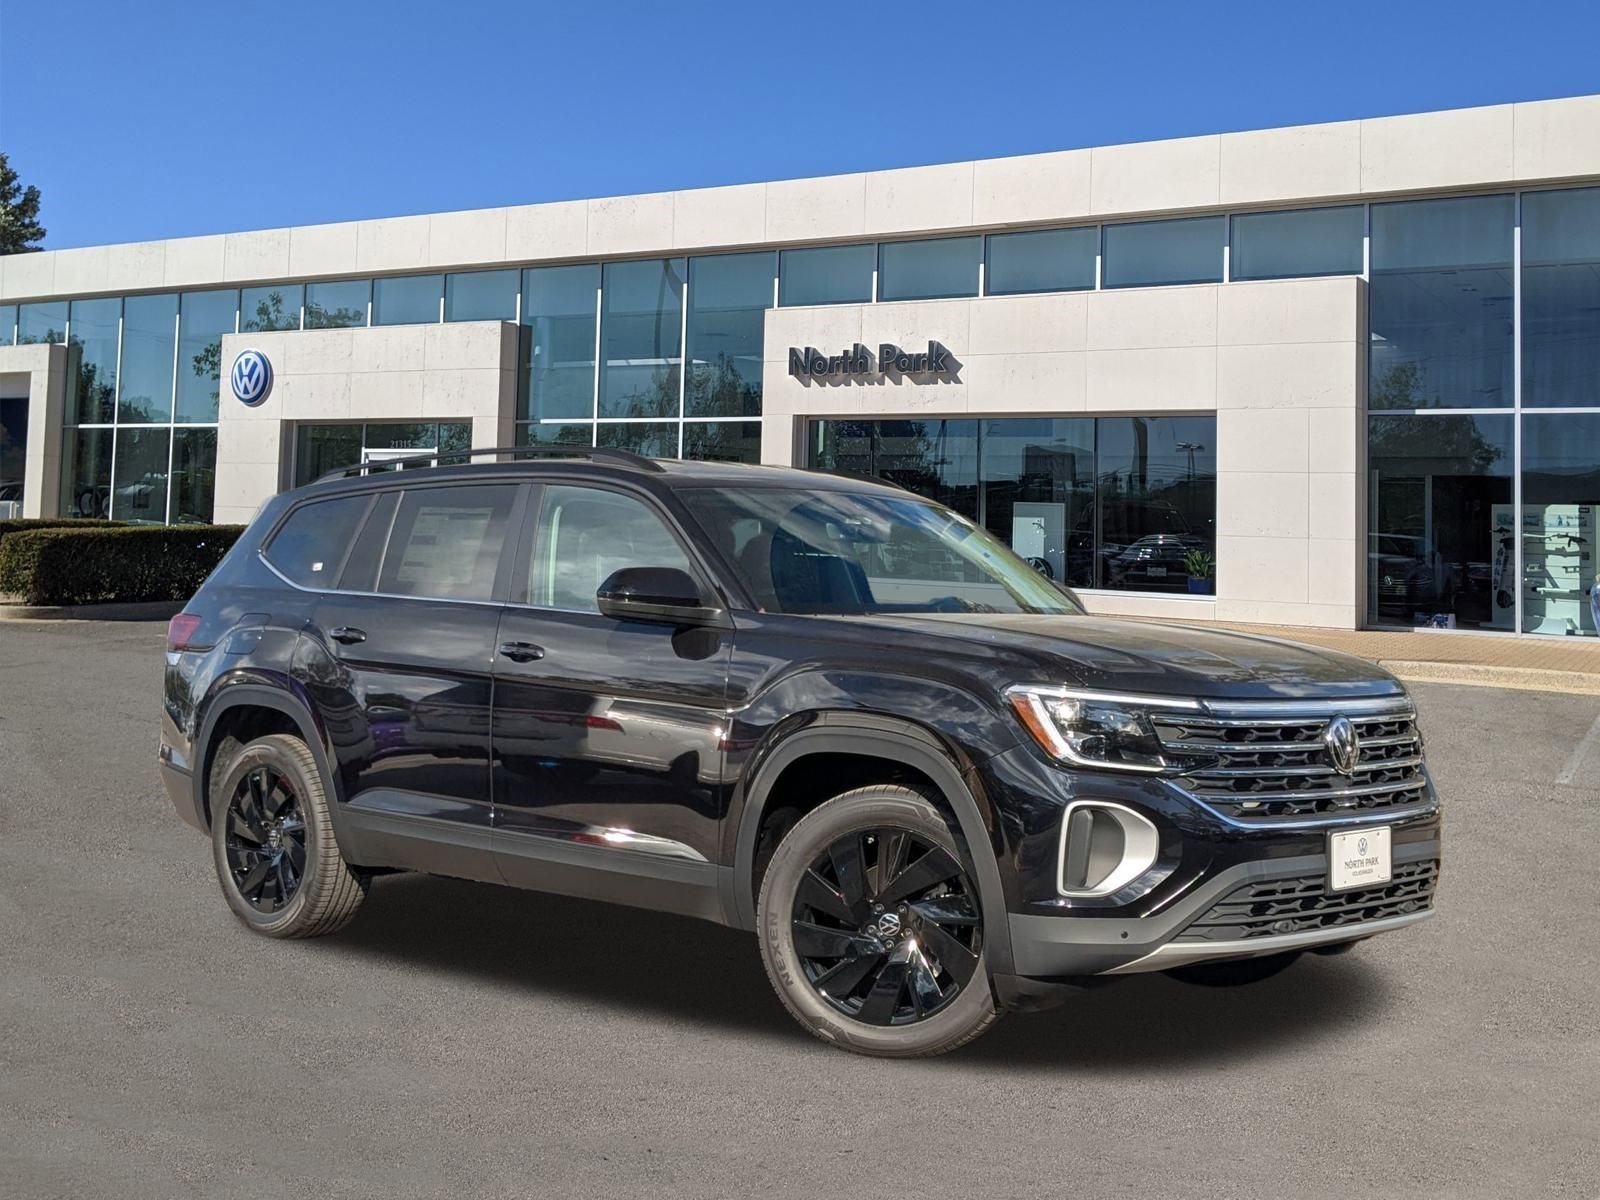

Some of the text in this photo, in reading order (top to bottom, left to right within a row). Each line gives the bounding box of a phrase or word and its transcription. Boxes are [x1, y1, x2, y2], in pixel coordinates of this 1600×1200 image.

[788, 340, 949, 377] North Park
[768, 912, 794, 986] NEXEN
